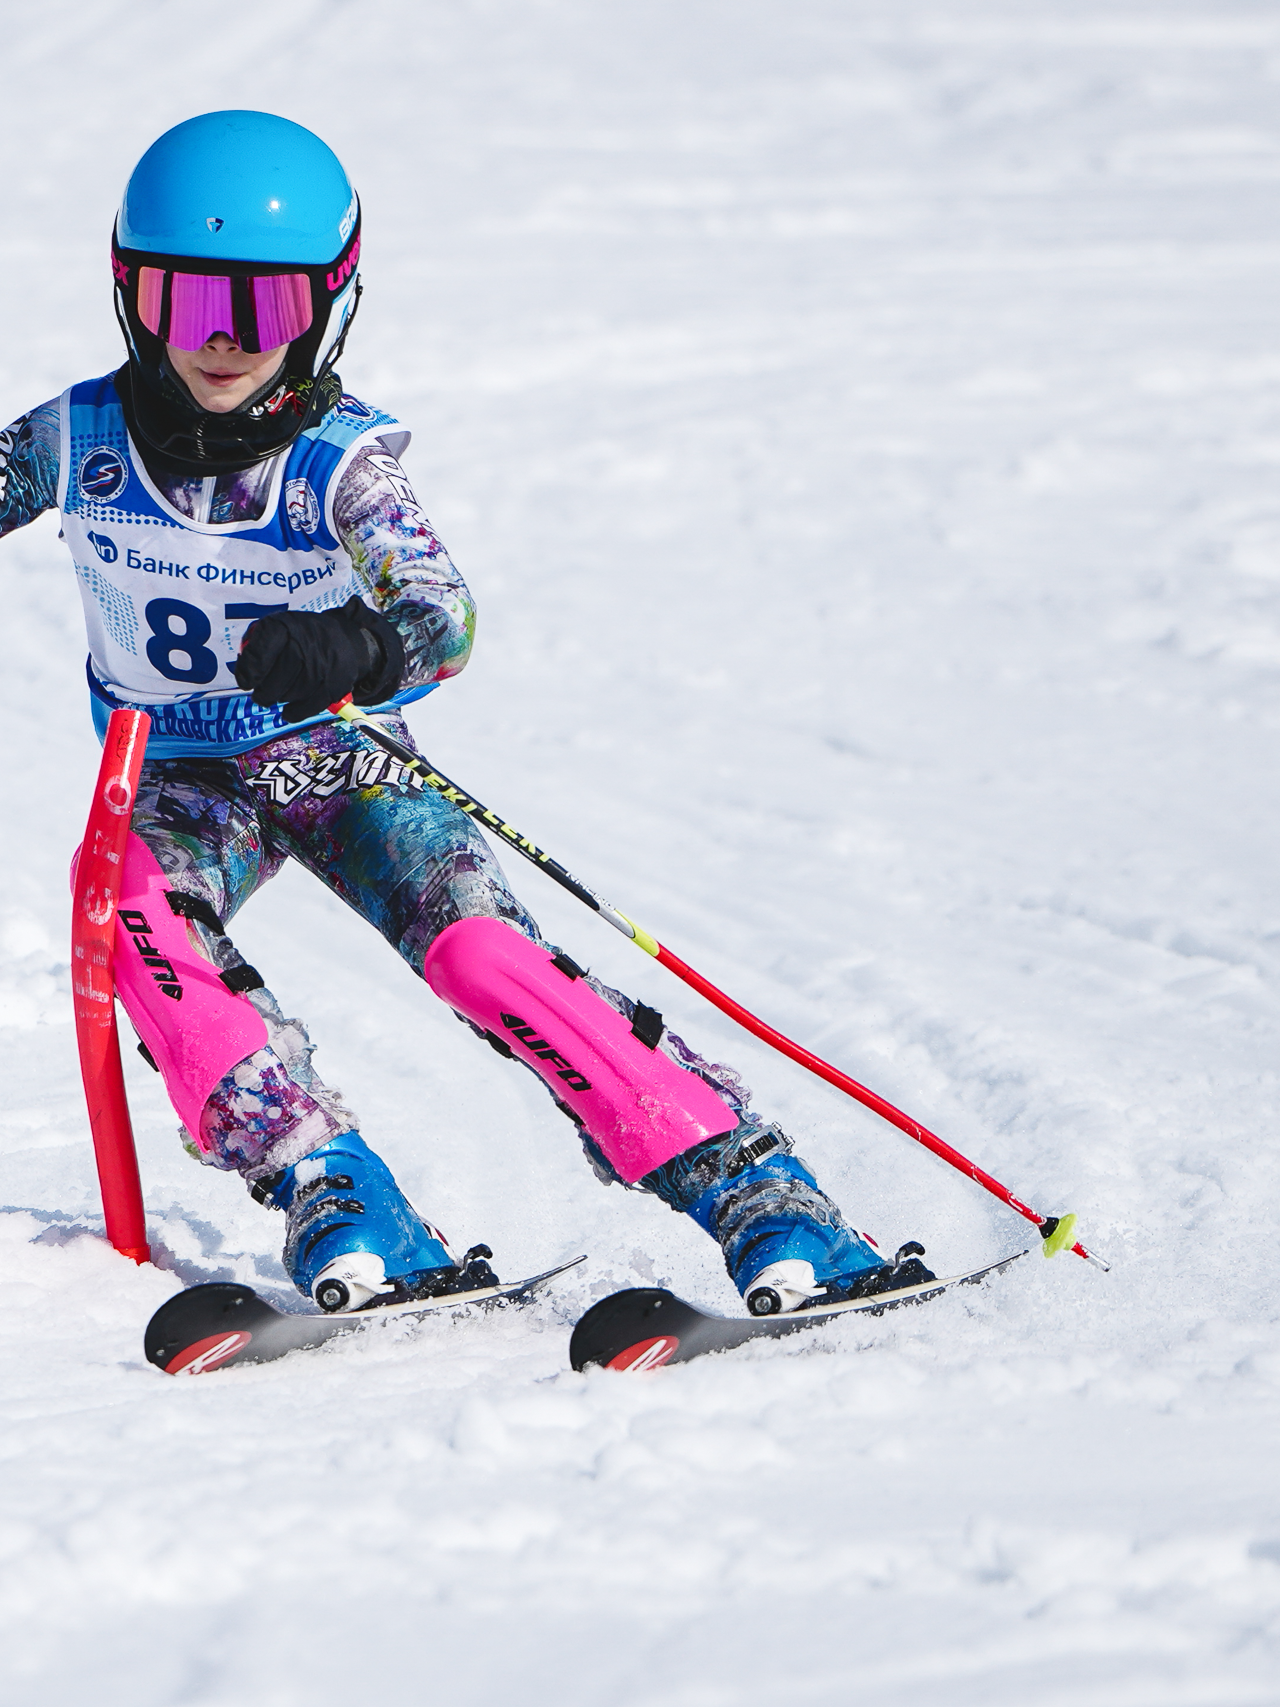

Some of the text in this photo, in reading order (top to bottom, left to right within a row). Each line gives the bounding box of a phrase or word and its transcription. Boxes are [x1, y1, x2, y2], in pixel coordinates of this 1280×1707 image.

[126, 549, 190, 580] Банк
[117, 909, 179, 983] UFO
[511, 1026, 593, 1092] UFO
